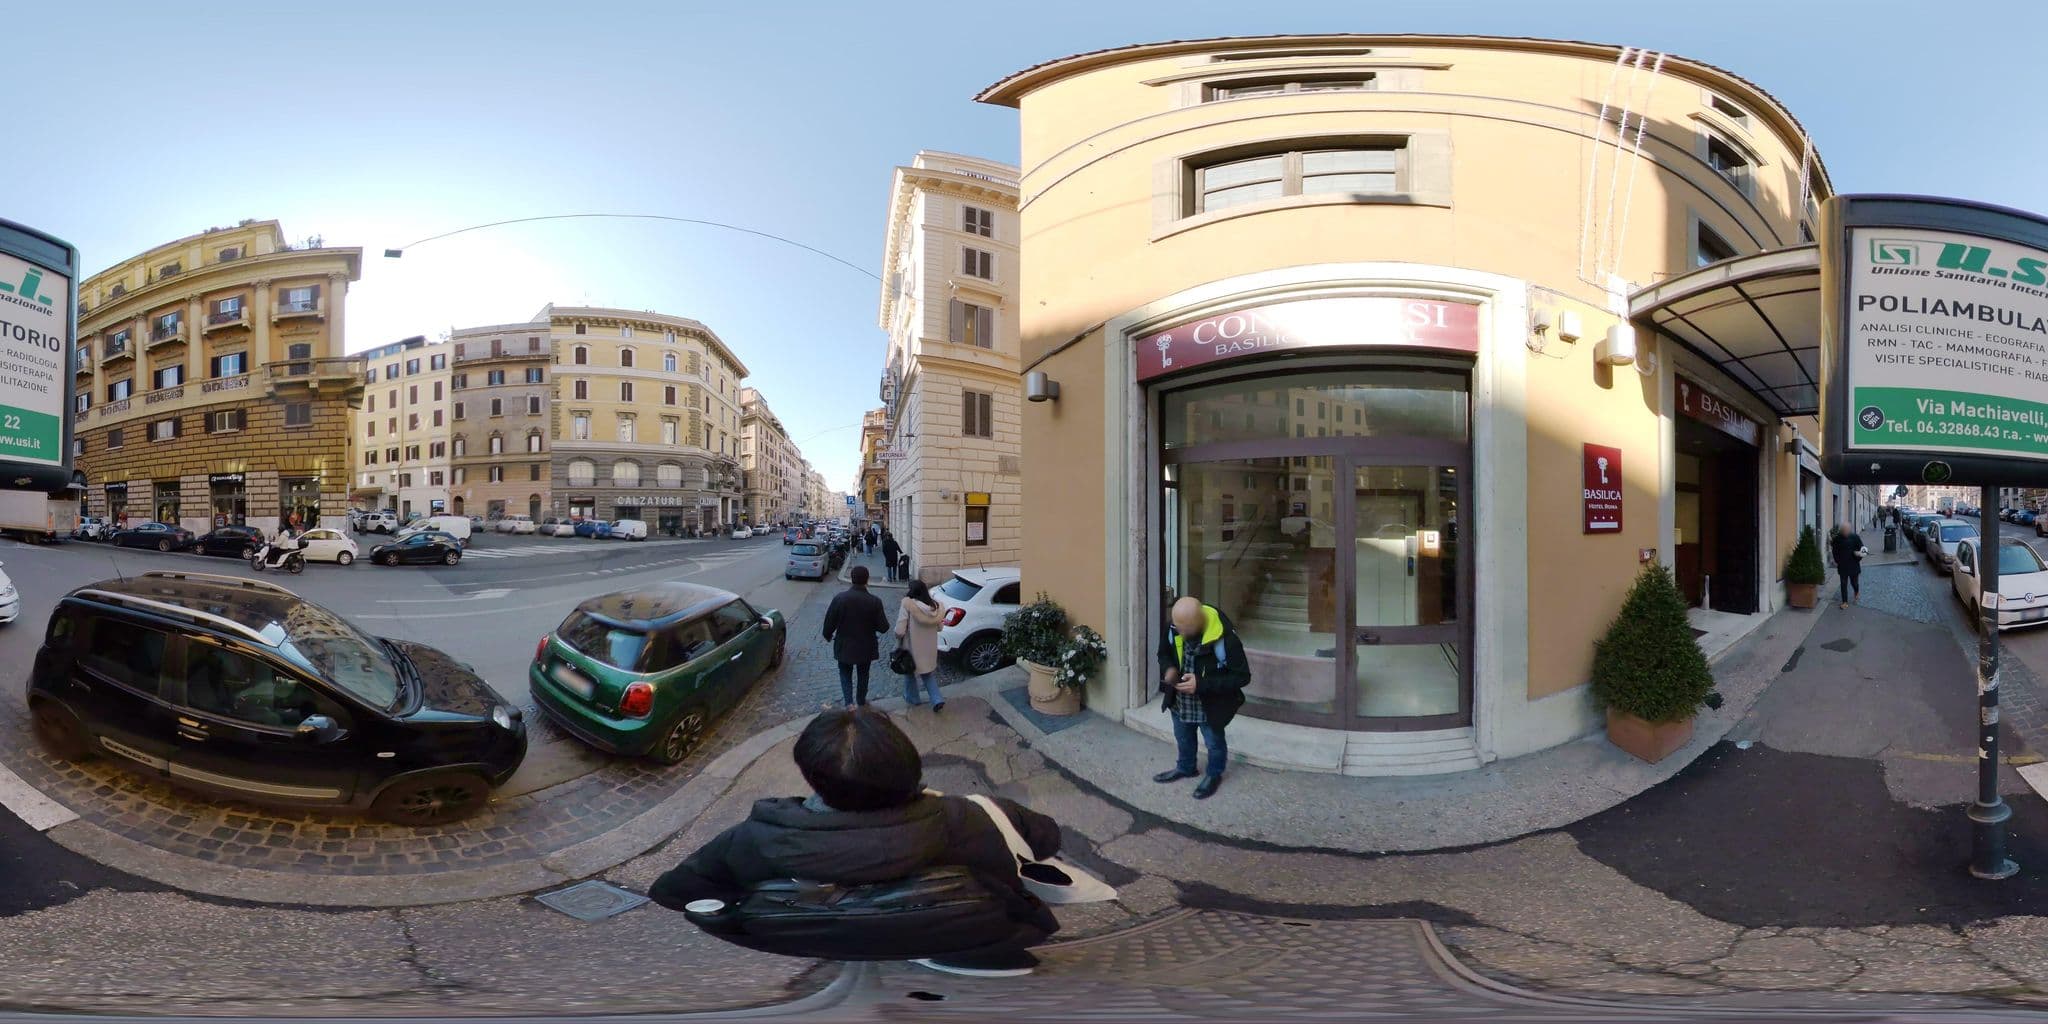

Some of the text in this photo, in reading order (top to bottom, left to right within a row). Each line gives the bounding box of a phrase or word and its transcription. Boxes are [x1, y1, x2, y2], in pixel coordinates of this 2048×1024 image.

[1871, 266, 1931, 277] Unione
[1935, 270, 2007, 288] Sanitaria
[1215, 333, 1298, 356] BASILIC
[1860, 323, 1912, 333] ANALISI
[1915, 325, 1974, 339] CLINICHE
[1985, 333, 2046, 353] ECOGRAFIA
[7, 349, 58, 370] RADIOLOGIA
[1867, 338, 1897, 347] RMN
[1911, 340, 1933, 350] TAC
[1946, 342, 2033, 365] MAMMOGRAFIA
[1875, 353, 1915, 365] VISITE
[1918, 356, 2015, 376] SPECIALISTICHE
[4, 414, 21, 430] 22
[1916, 398, 2048, 429] Via Machiavelli,
[1886, 420, 1913, 433] Tel.
[1916, 420, 2000, 438] 06.32868.43
[2003, 430, 2022, 441] r.a.
[617, 496, 682, 506] CALZATURE
[1584, 489, 1621, 500] BASILICA
